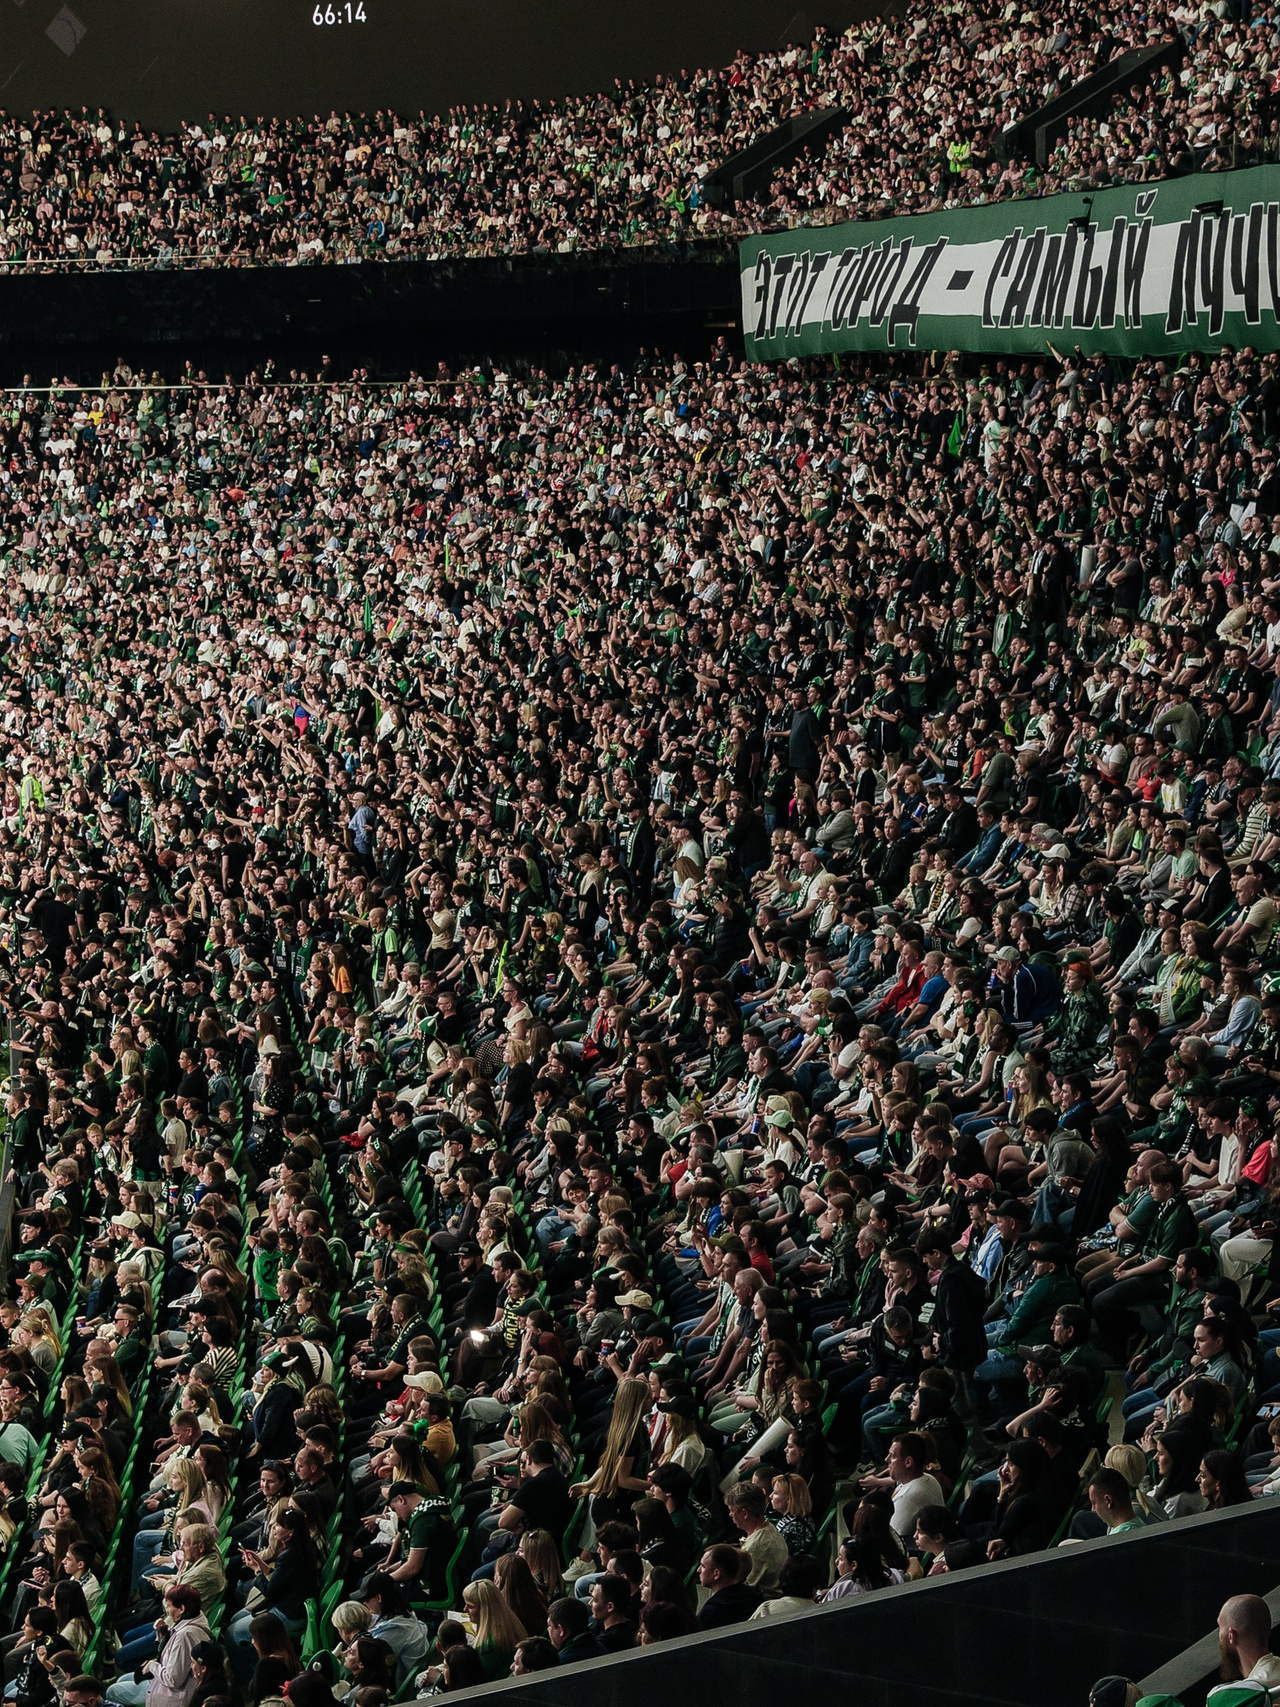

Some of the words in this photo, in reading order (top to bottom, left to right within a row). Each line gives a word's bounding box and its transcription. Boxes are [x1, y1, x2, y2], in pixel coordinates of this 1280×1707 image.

[312, 2, 367, 26] 66:14
[820, 236, 950, 346] ГОРОД
[981, 188, 1159, 329] САМЫЙ
